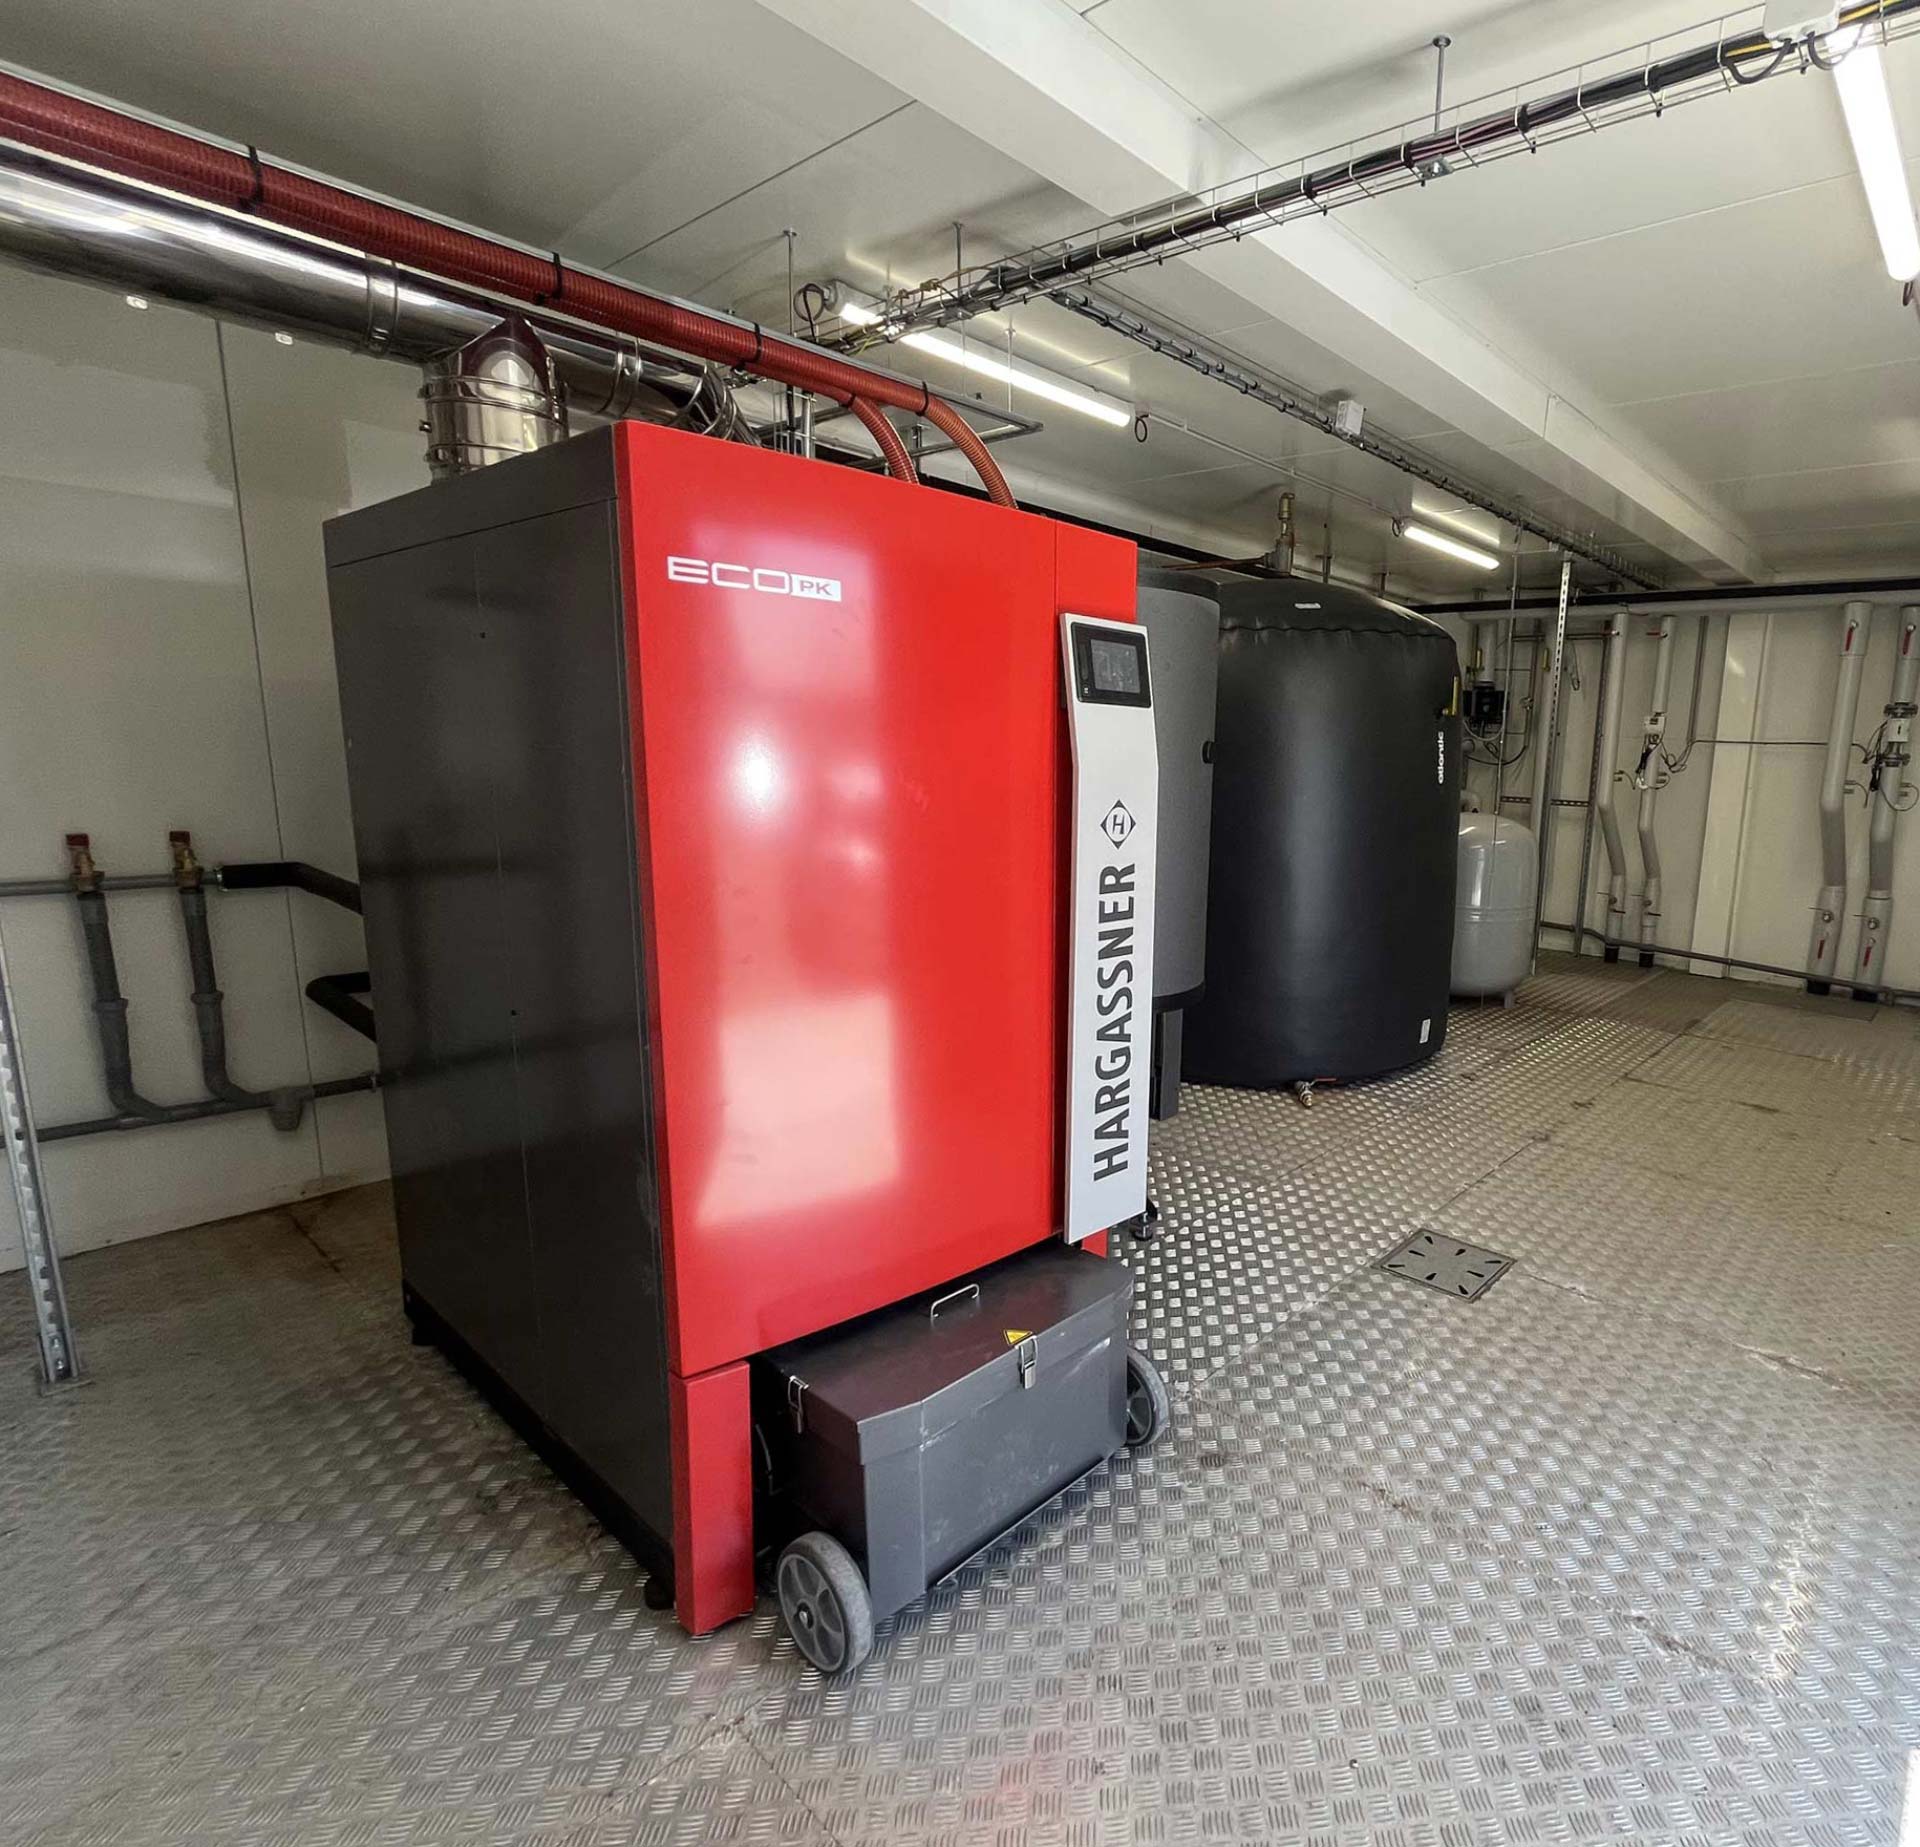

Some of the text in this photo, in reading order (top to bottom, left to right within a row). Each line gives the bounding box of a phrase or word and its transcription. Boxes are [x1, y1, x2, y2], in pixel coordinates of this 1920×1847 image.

[667, 556, 832, 597] ECO PK
[1093, 863, 1136, 1181] HARGASSNER
